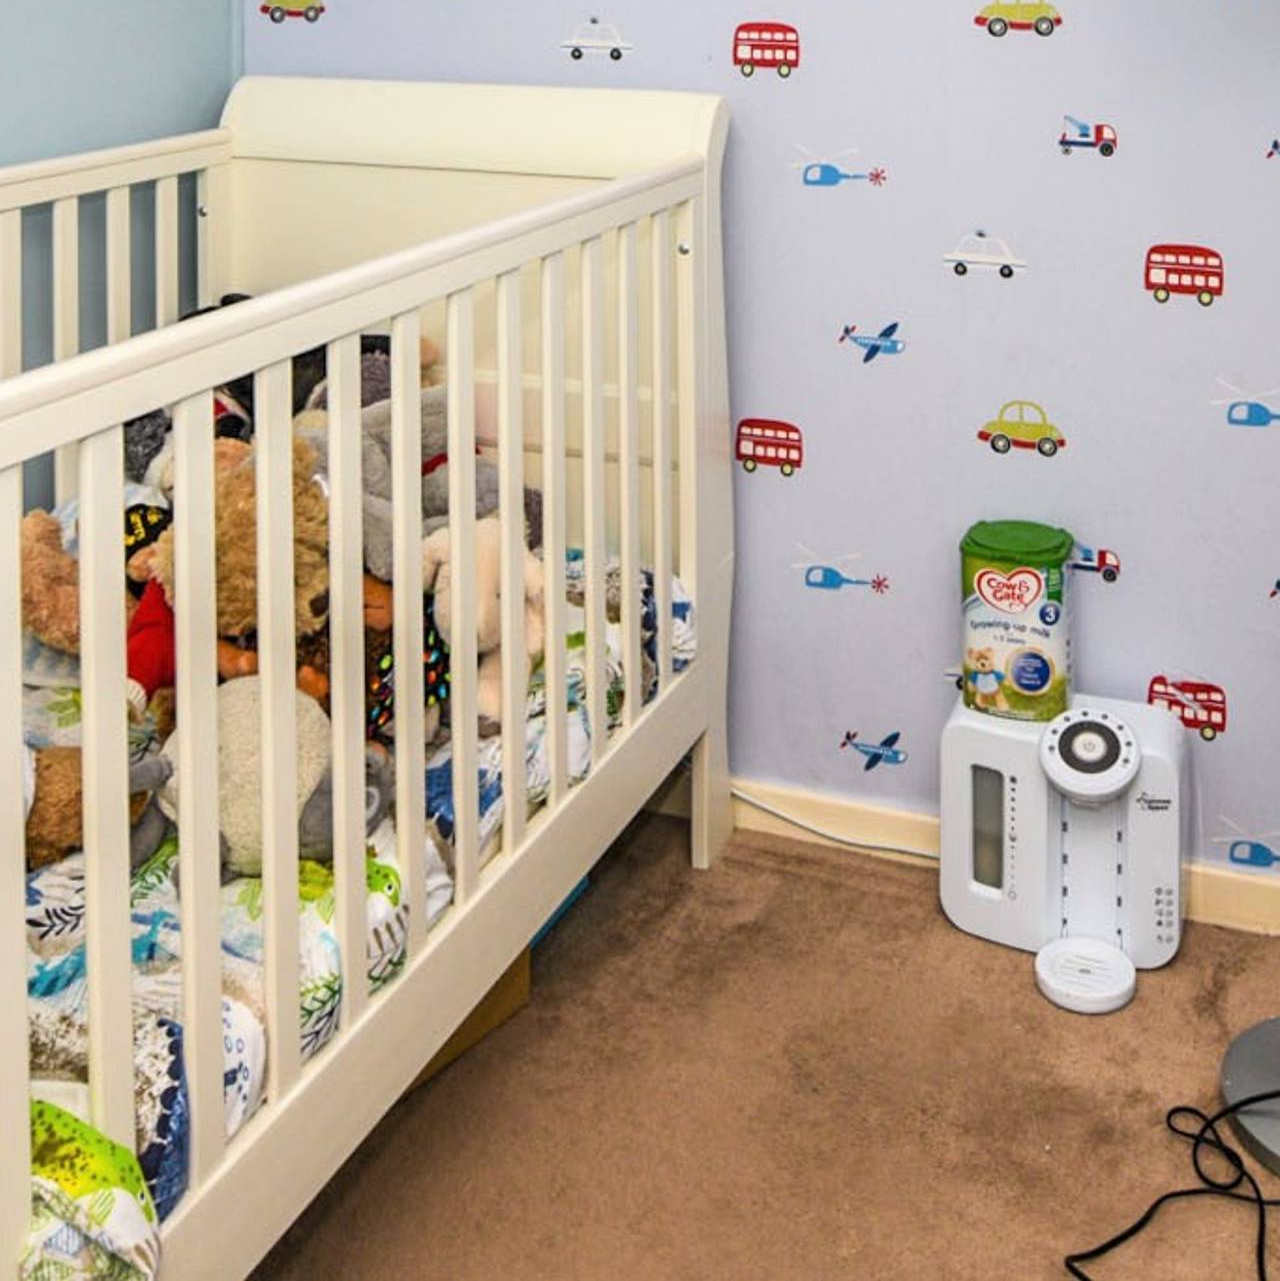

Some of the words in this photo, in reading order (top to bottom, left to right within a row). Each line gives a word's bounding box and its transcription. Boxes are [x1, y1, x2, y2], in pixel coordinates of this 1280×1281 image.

[987, 578, 1017, 591] Cow
[992, 589, 1025, 604] Gate
[1044, 606, 1056, 623] 3
